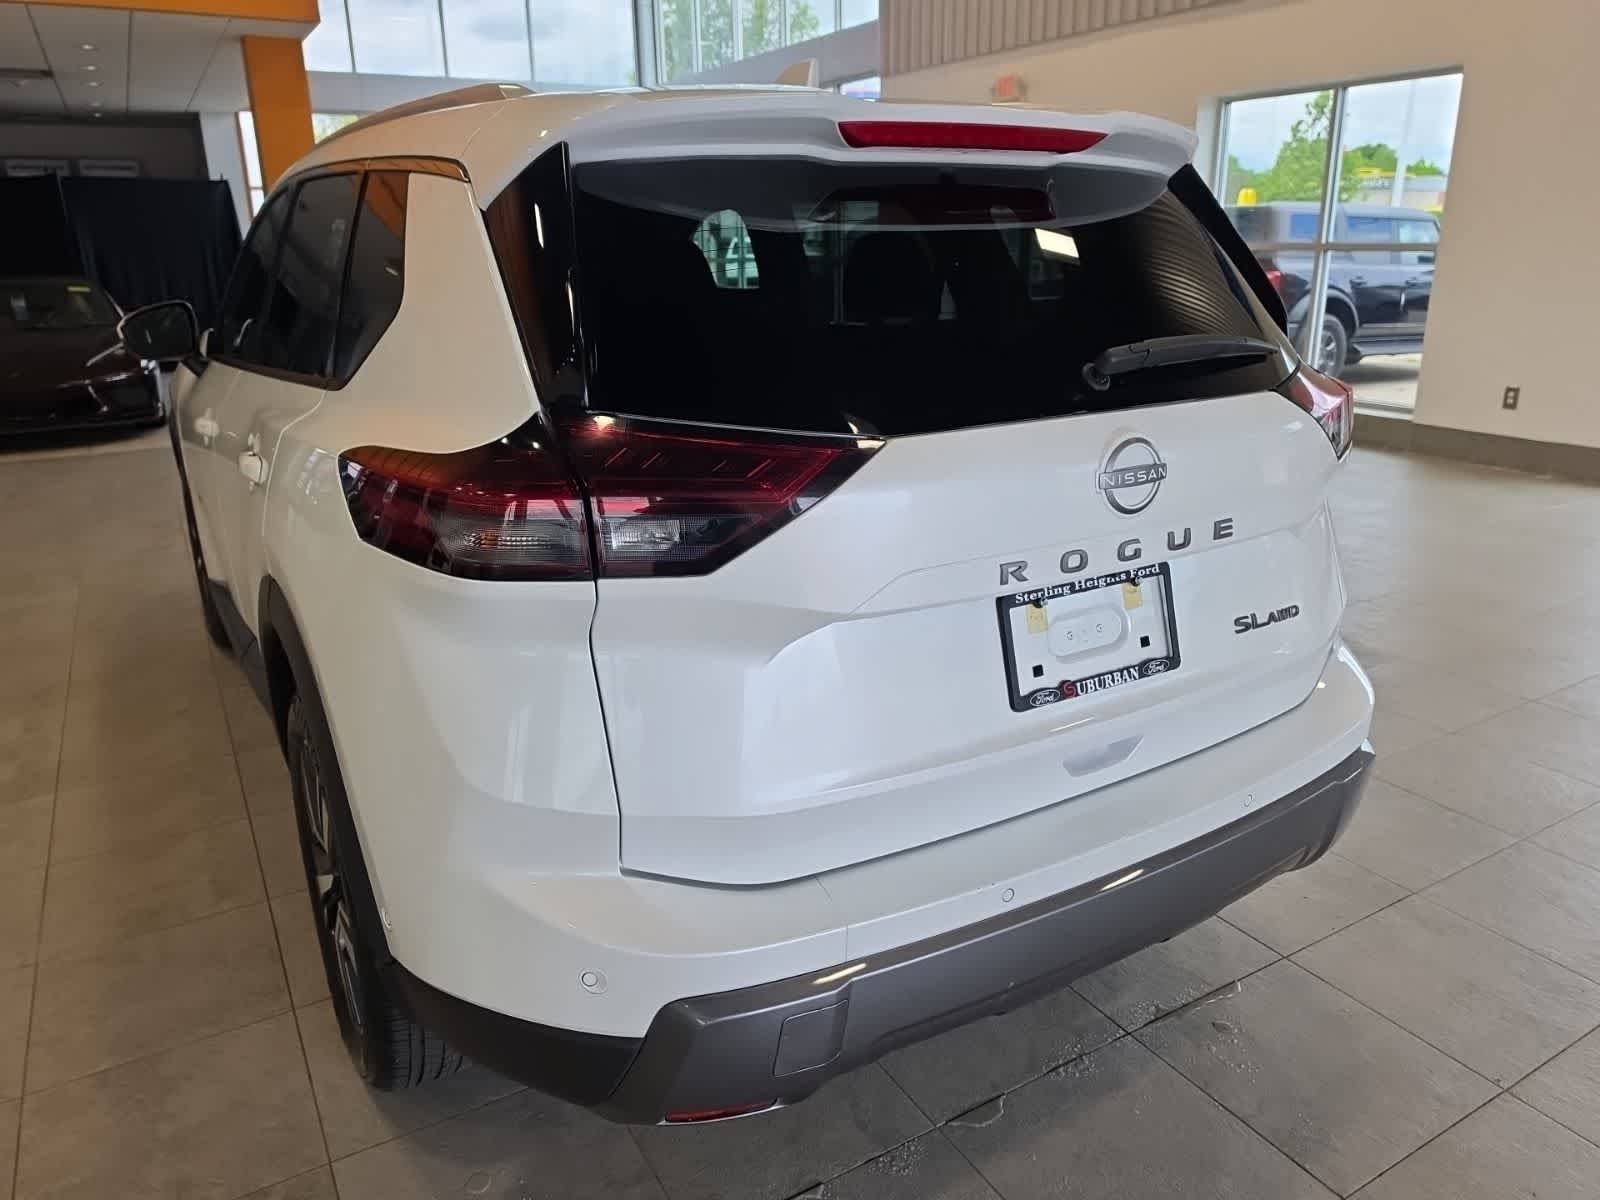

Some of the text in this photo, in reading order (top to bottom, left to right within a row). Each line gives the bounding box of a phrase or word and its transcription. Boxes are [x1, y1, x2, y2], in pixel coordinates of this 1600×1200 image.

[1099, 465, 1167, 488] NISSAN
[998, 517, 1234, 586] ROGUE
[1015, 585, 1071, 604] Sterling
[1129, 563, 1161, 579] Ford
[1034, 660, 1166, 705] Ford SUBURBAN Ford
